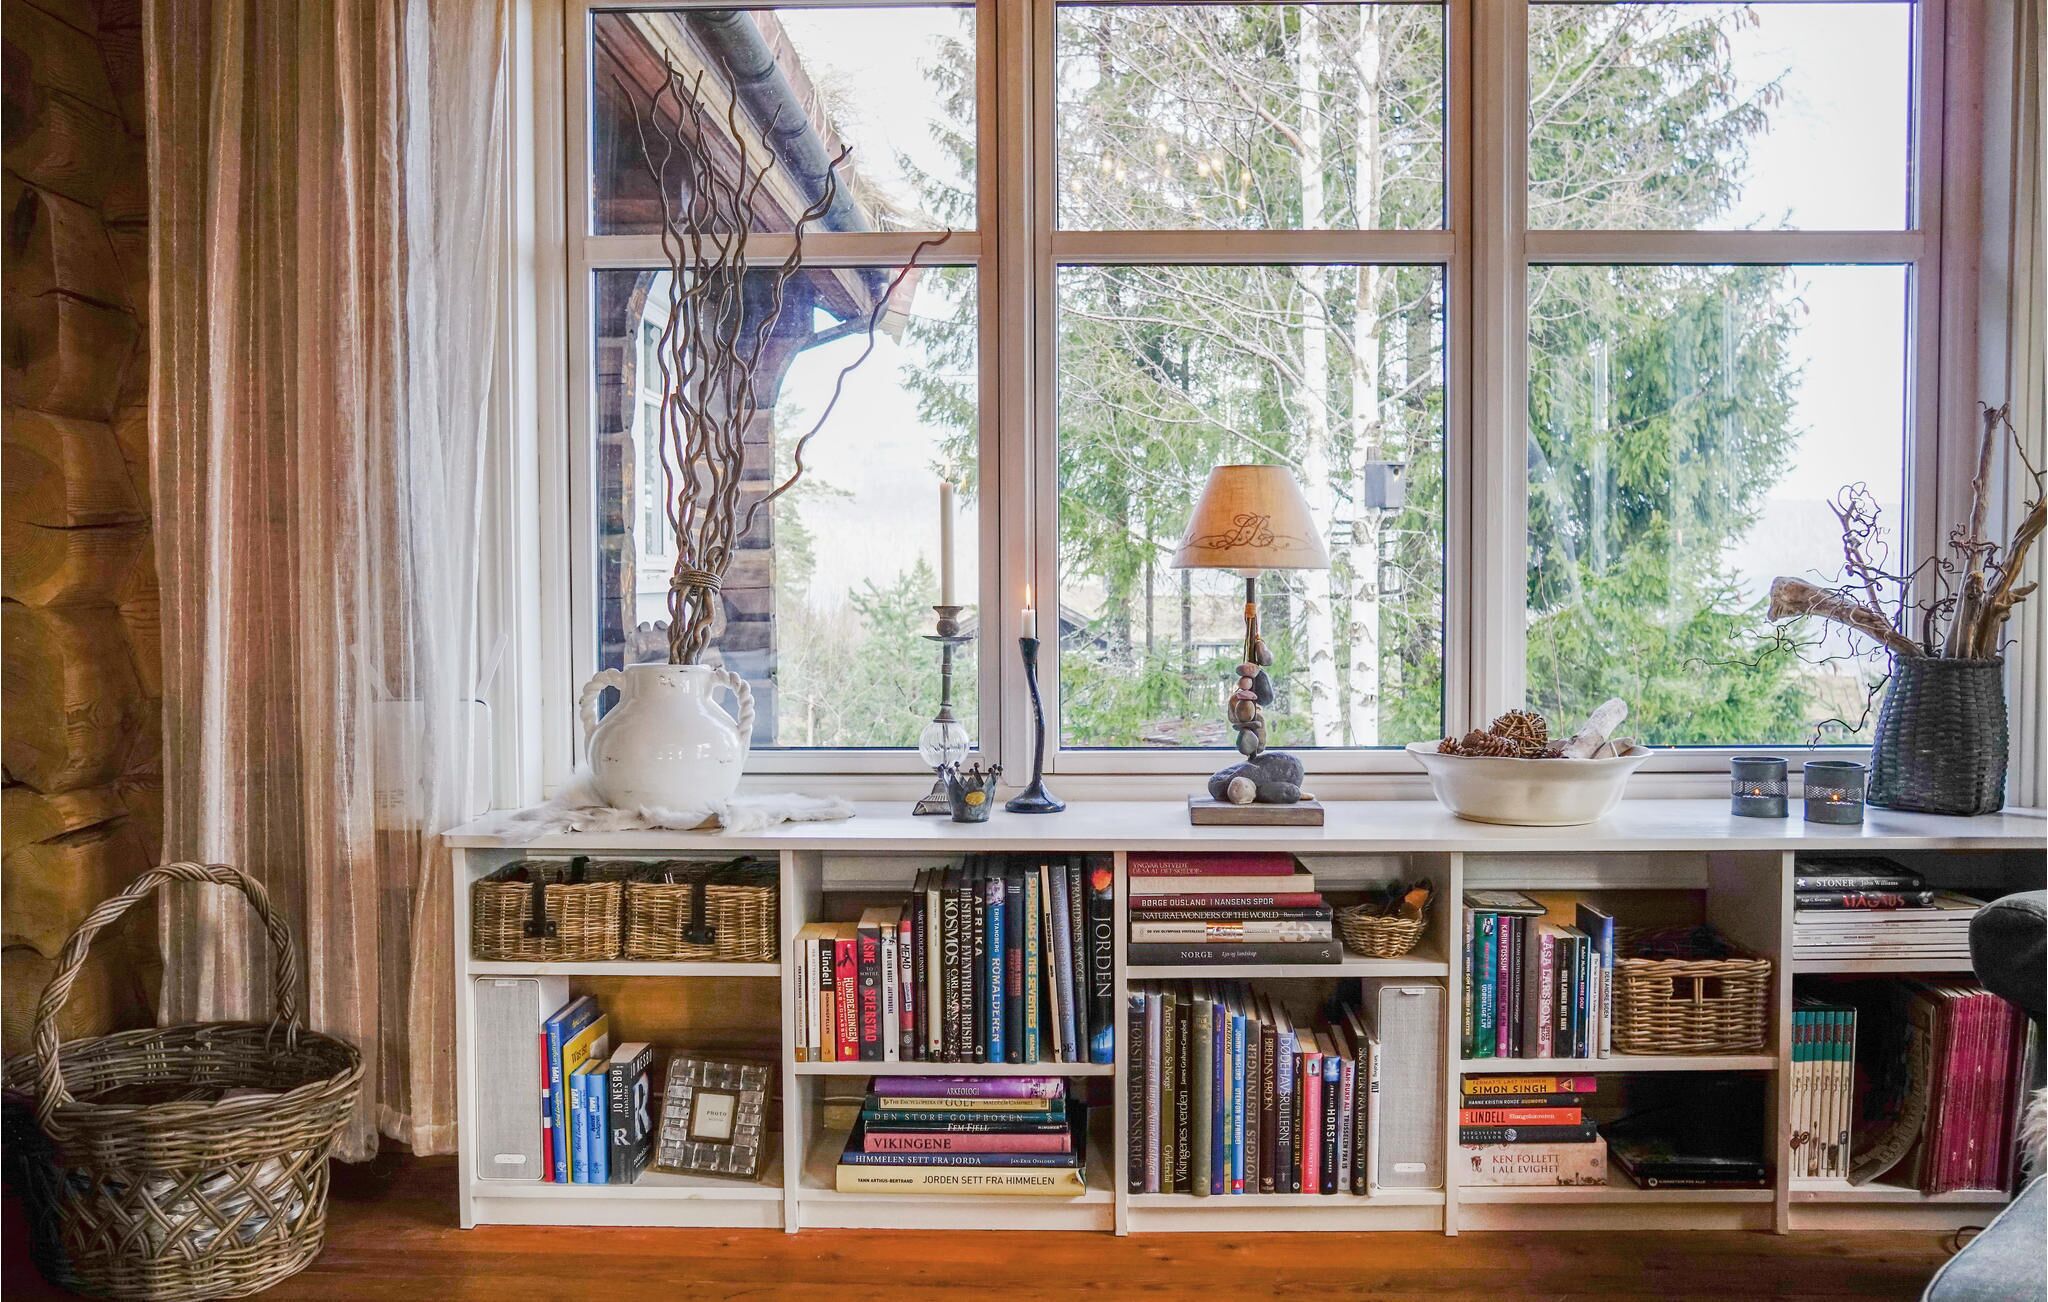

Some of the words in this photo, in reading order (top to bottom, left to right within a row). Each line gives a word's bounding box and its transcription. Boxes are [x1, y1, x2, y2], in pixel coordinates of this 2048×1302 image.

[1072, 874, 1082, 943] PYRAMIDENES
[1141, 899, 1168, 907] BØRGE
[1214, 898, 1251, 906] NANSENS
[1142, 912, 1180, 920] NATURAL
[1180, 911, 1220, 919] WONDERS
[1221, 911, 1232, 919] OF
[1232, 911, 1248, 919] THE
[1249, 911, 1279, 919] WORLD
[961, 903, 972, 930] STEIN
[974, 895, 983, 958] AFRIKA
[944, 898, 960, 966] KOSMOS
[1500, 924, 1508, 944] KARIN
[863, 937, 877, 964] ÅSNE
[901, 943, 911, 969] MEMO
[1092, 916, 1112, 999] JORDEN
[1500, 945, 1508, 971] FOSSUM
[1542, 943, 1552, 966] ÅSA
[822, 950, 832, 985] Lindell
[961, 945, 972, 1009] EVENTYRLIGE
[1028, 957, 1036, 976] THE
[1074, 946, 1085, 983] SKYGGE
[949, 968, 958, 992] CARL
[843, 977, 858, 1042] HUNDREÅRINGEN
[992, 958, 1001, 1043] ROMALDEREN
[1542, 968, 1551, 1024] LARSSON
[838, 1004, 846, 1043] JONASSON
[864, 988, 877, 1043] SEIERSTAD
[1164, 1005, 1173, 1025] Arne
[1560, 1005, 1568, 1017] MITT
[961, 1014, 972, 1049] REISER
[1164, 1025, 1174, 1054] Beskow
[1180, 1019, 1188, 1068] Graham-Campbell
[1234, 1028, 1242, 1052] JOHNNY
[1164, 1056, 1173, 1065] Se
[1264, 1037, 1274, 1074] BIBELENS
[1358, 1047, 1367, 1090] SKATTER
[612, 1070, 623, 1101] NESBØ
[1180, 1069, 1188, 1085] James
[1245, 1043, 1257, 1124] FESTNINGER
[1371, 1080, 1379, 1093] VILT
[1473, 1086, 1508, 1094] SIMON
[1513, 1085, 1547, 1093] SINGH
[945, 1099, 976, 1107] GOLF
[946, 1087, 980, 1096] ARKEOLOGI
[1264, 1075, 1273, 1111] VERDEN
[1279, 1037, 1291, 1146] DØDEHAVSRULLERNE
[1358, 1091, 1367, 1110] FRA
[613, 1103, 623, 1113] JO
[904, 1113, 943, 1121] STORE
[949, 1114, 1023, 1122] GOLFBOKEN
[1129, 1075, 1142, 1168] VERDENSKRIG
[1176, 1090, 1188, 1126] verden
[1470, 1111, 1506, 1123] LINDELL
[1326, 1108, 1336, 1143] HORST
[1358, 1112, 1366, 1150] BIBELSK
[873, 1138, 952, 1149] VIKINGENE
[1176, 1128, 1191, 1182] Vikingenes
[1246, 1130, 1256, 1184] NORGES
[855, 1155, 904, 1163] HIMMELEN
[907, 1156, 930, 1164] SETT
[932, 1156, 949, 1164] FRA
[951, 1157, 982, 1166] JORDA
[1163, 1144, 1173, 1183] Gyldendal
[1357, 1152, 1366, 1169] TID
[1492, 1154, 1513, 1164] KEN
[1517, 1154, 1560, 1163] FOLLETT
[1499, 1165, 1514, 1174] ALL
[1518, 1165, 1559, 1174] EVIGHET
[922, 1175, 959, 1184] JORDEN
[961, 1176, 983, 1185] SETT
[985, 1176, 1004, 1185] FRA
[1006, 1176, 1055, 1185] HIMMELEN
